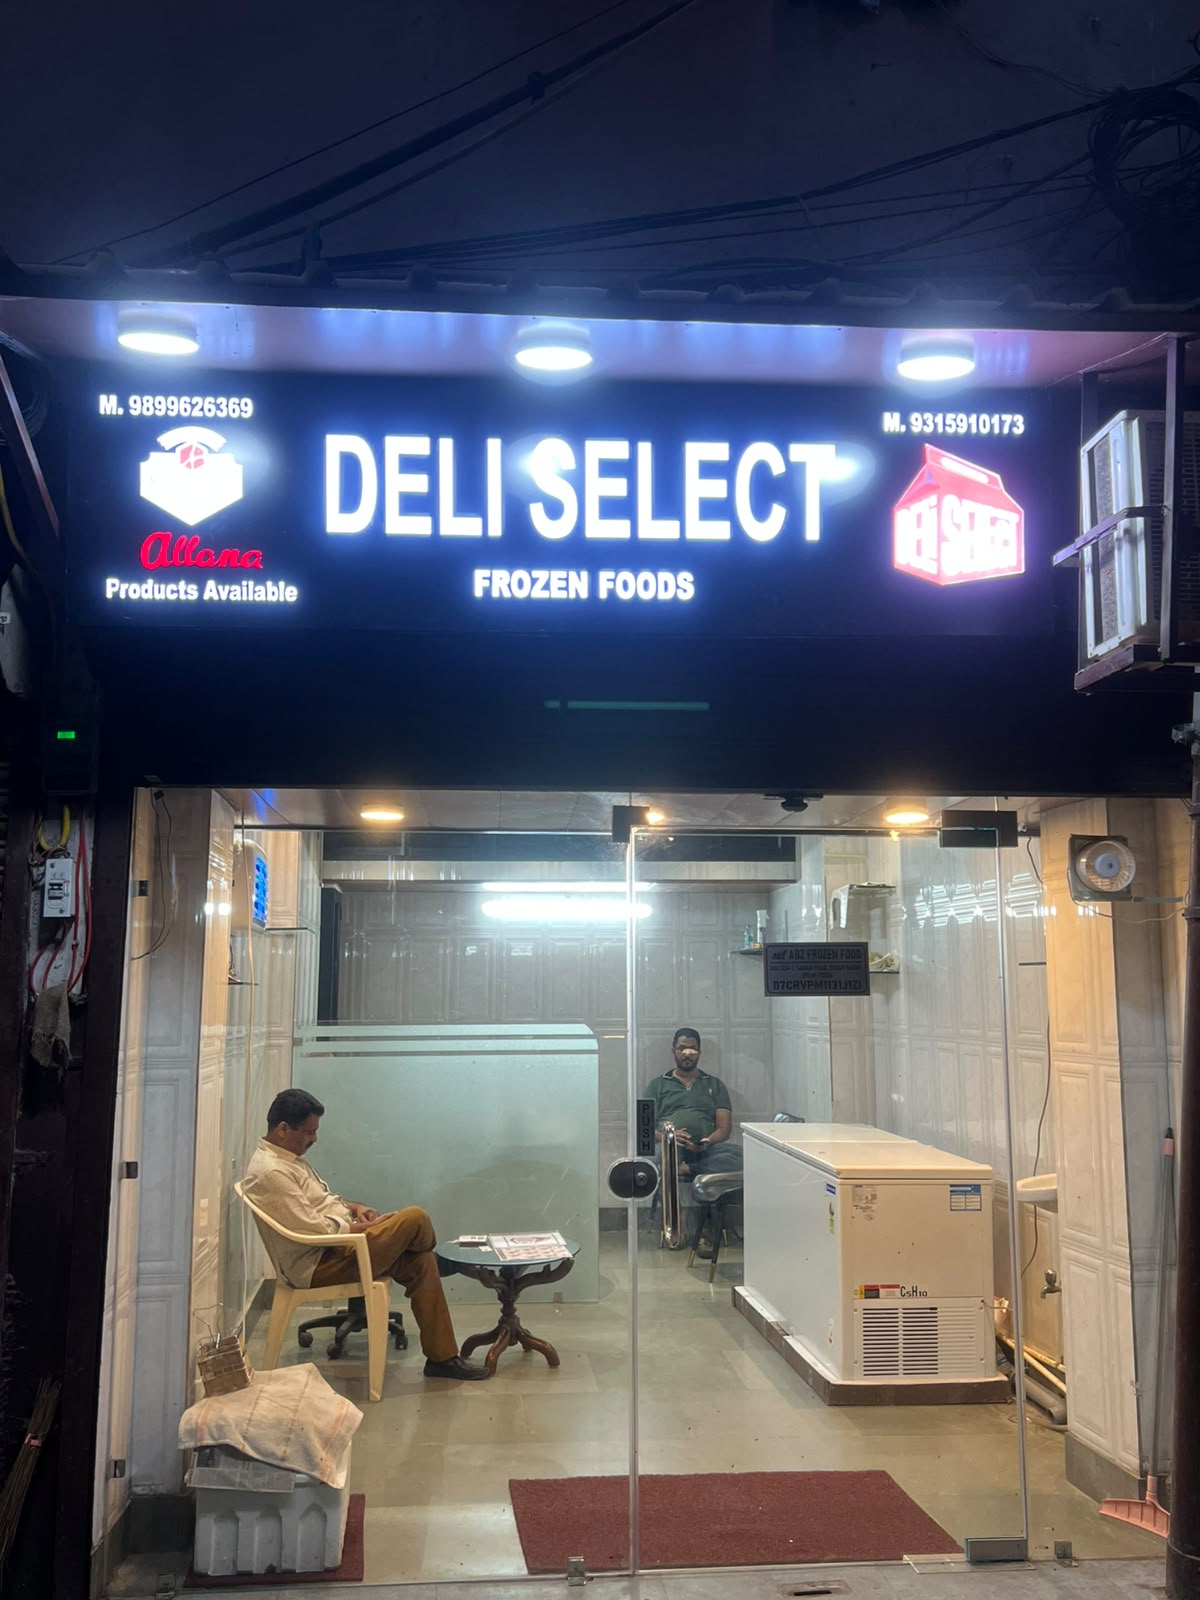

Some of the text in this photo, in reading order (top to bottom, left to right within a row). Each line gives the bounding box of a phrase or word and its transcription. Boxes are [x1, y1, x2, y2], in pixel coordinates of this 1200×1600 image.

[99, 394, 253, 419] M. 9899626369
[883, 411, 1025, 435] M. 9315910173
[325, 434, 837, 543] DELI SELECT
[140, 532, 263, 570] Allana
[105, 578, 298, 603] Products Available
[473, 569, 695, 601] FROZEN FOODS
[642, 1103, 650, 1151] PUSH
